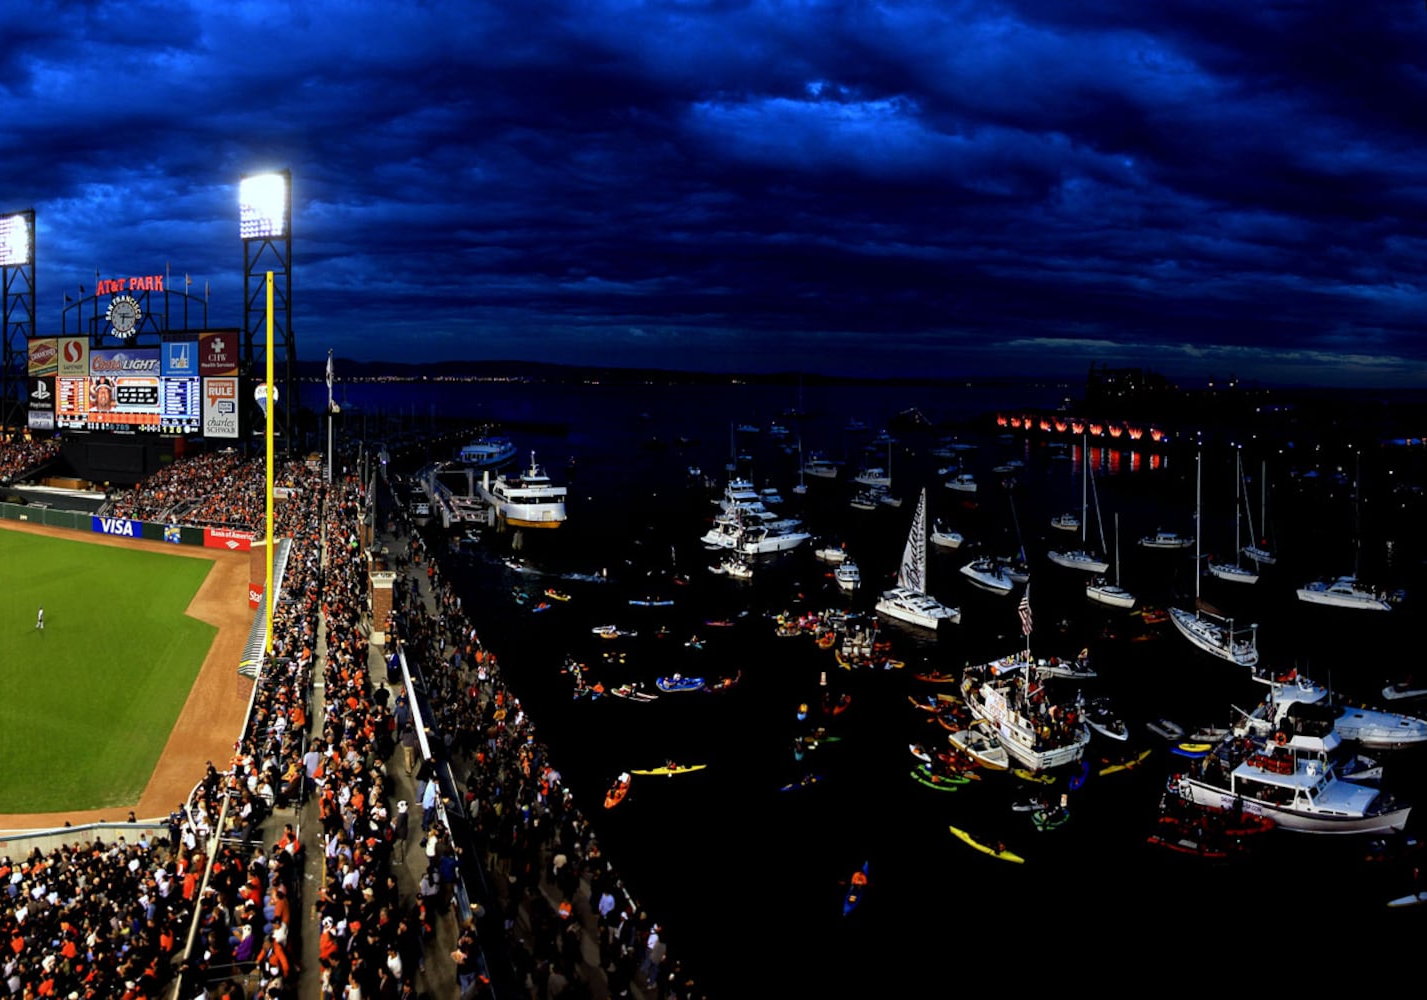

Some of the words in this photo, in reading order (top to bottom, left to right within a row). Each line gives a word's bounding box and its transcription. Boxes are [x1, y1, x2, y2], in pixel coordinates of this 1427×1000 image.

[96, 279, 126, 296] AT&T
[129, 275, 164, 292] PARK
[110, 327, 136, 339] GIANTS
[122, 359, 157, 370] LIGHT
[208, 387, 233, 396] RULE
[206, 417, 234, 427] charles
[100, 518, 133, 536] VISA
[210, 528, 225, 537] Bank
